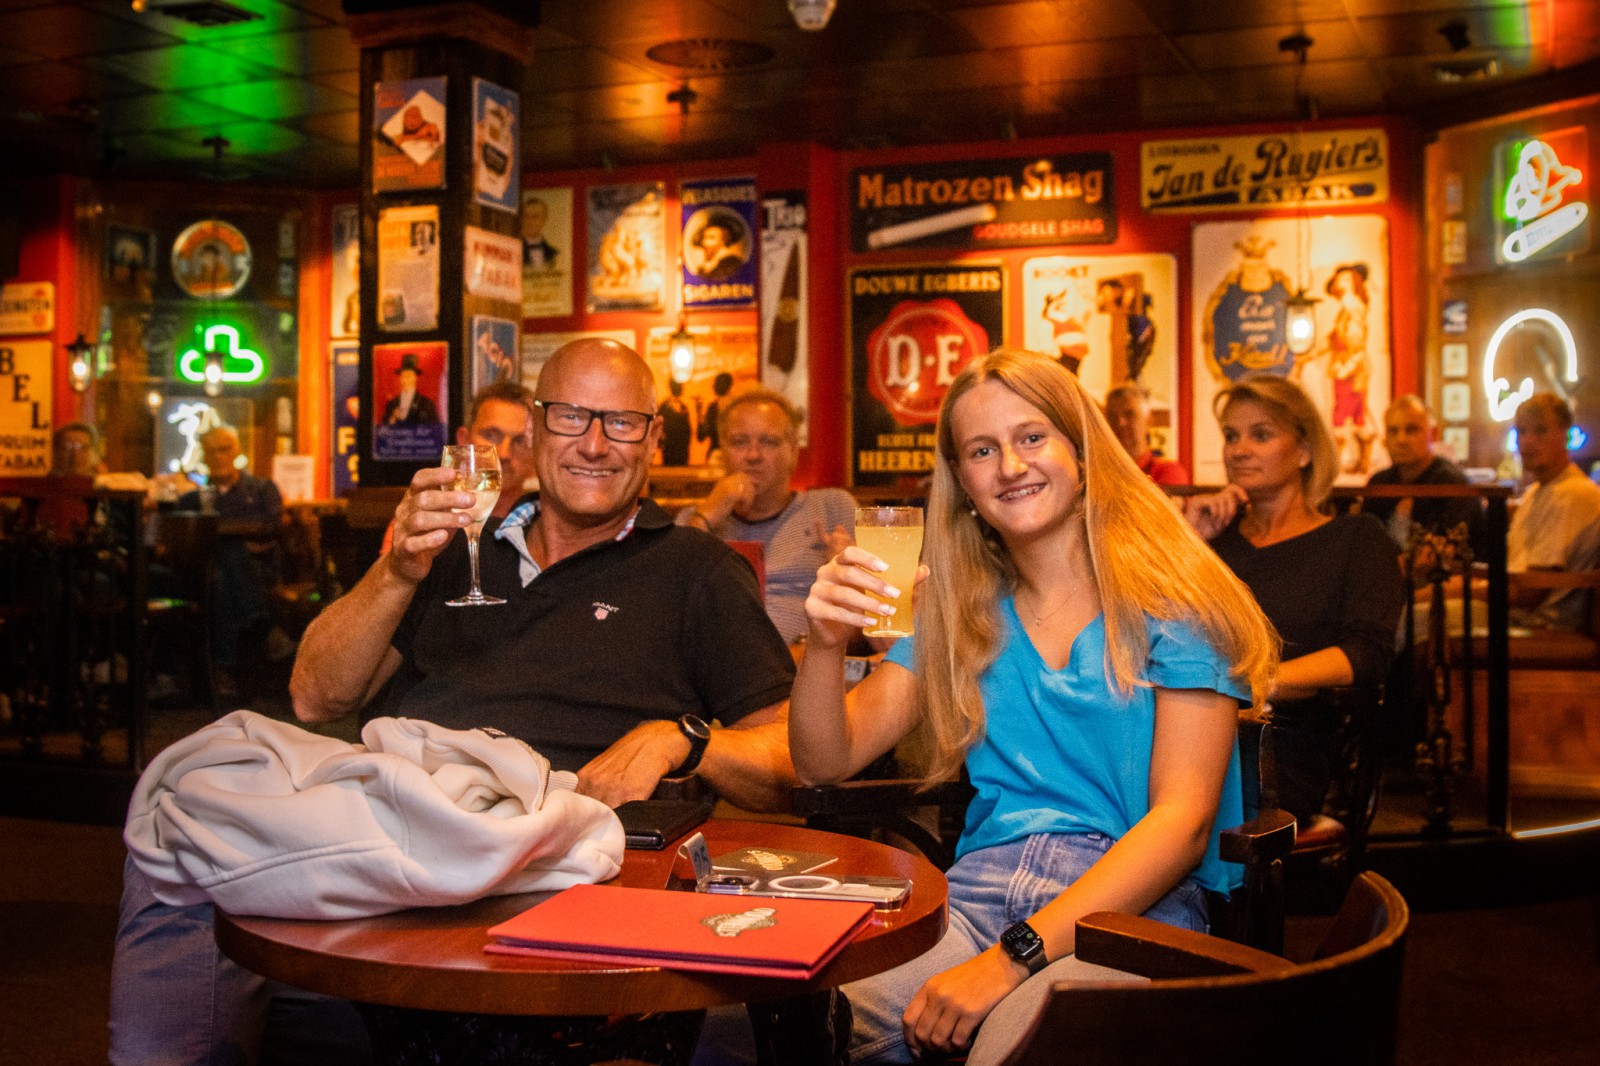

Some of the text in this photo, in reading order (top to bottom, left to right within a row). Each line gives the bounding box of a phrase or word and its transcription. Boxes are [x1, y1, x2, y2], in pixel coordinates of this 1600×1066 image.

[858, 160, 1104, 209] Matrozen Shag
[1147, 163, 1204, 199] Jan
[1213, 154, 1246, 188] de
[1060, 219, 1104, 236] SHAG
[683, 283, 753, 303] SIGAREN
[854, 271, 1001, 295] DOUWE EGBERTS
